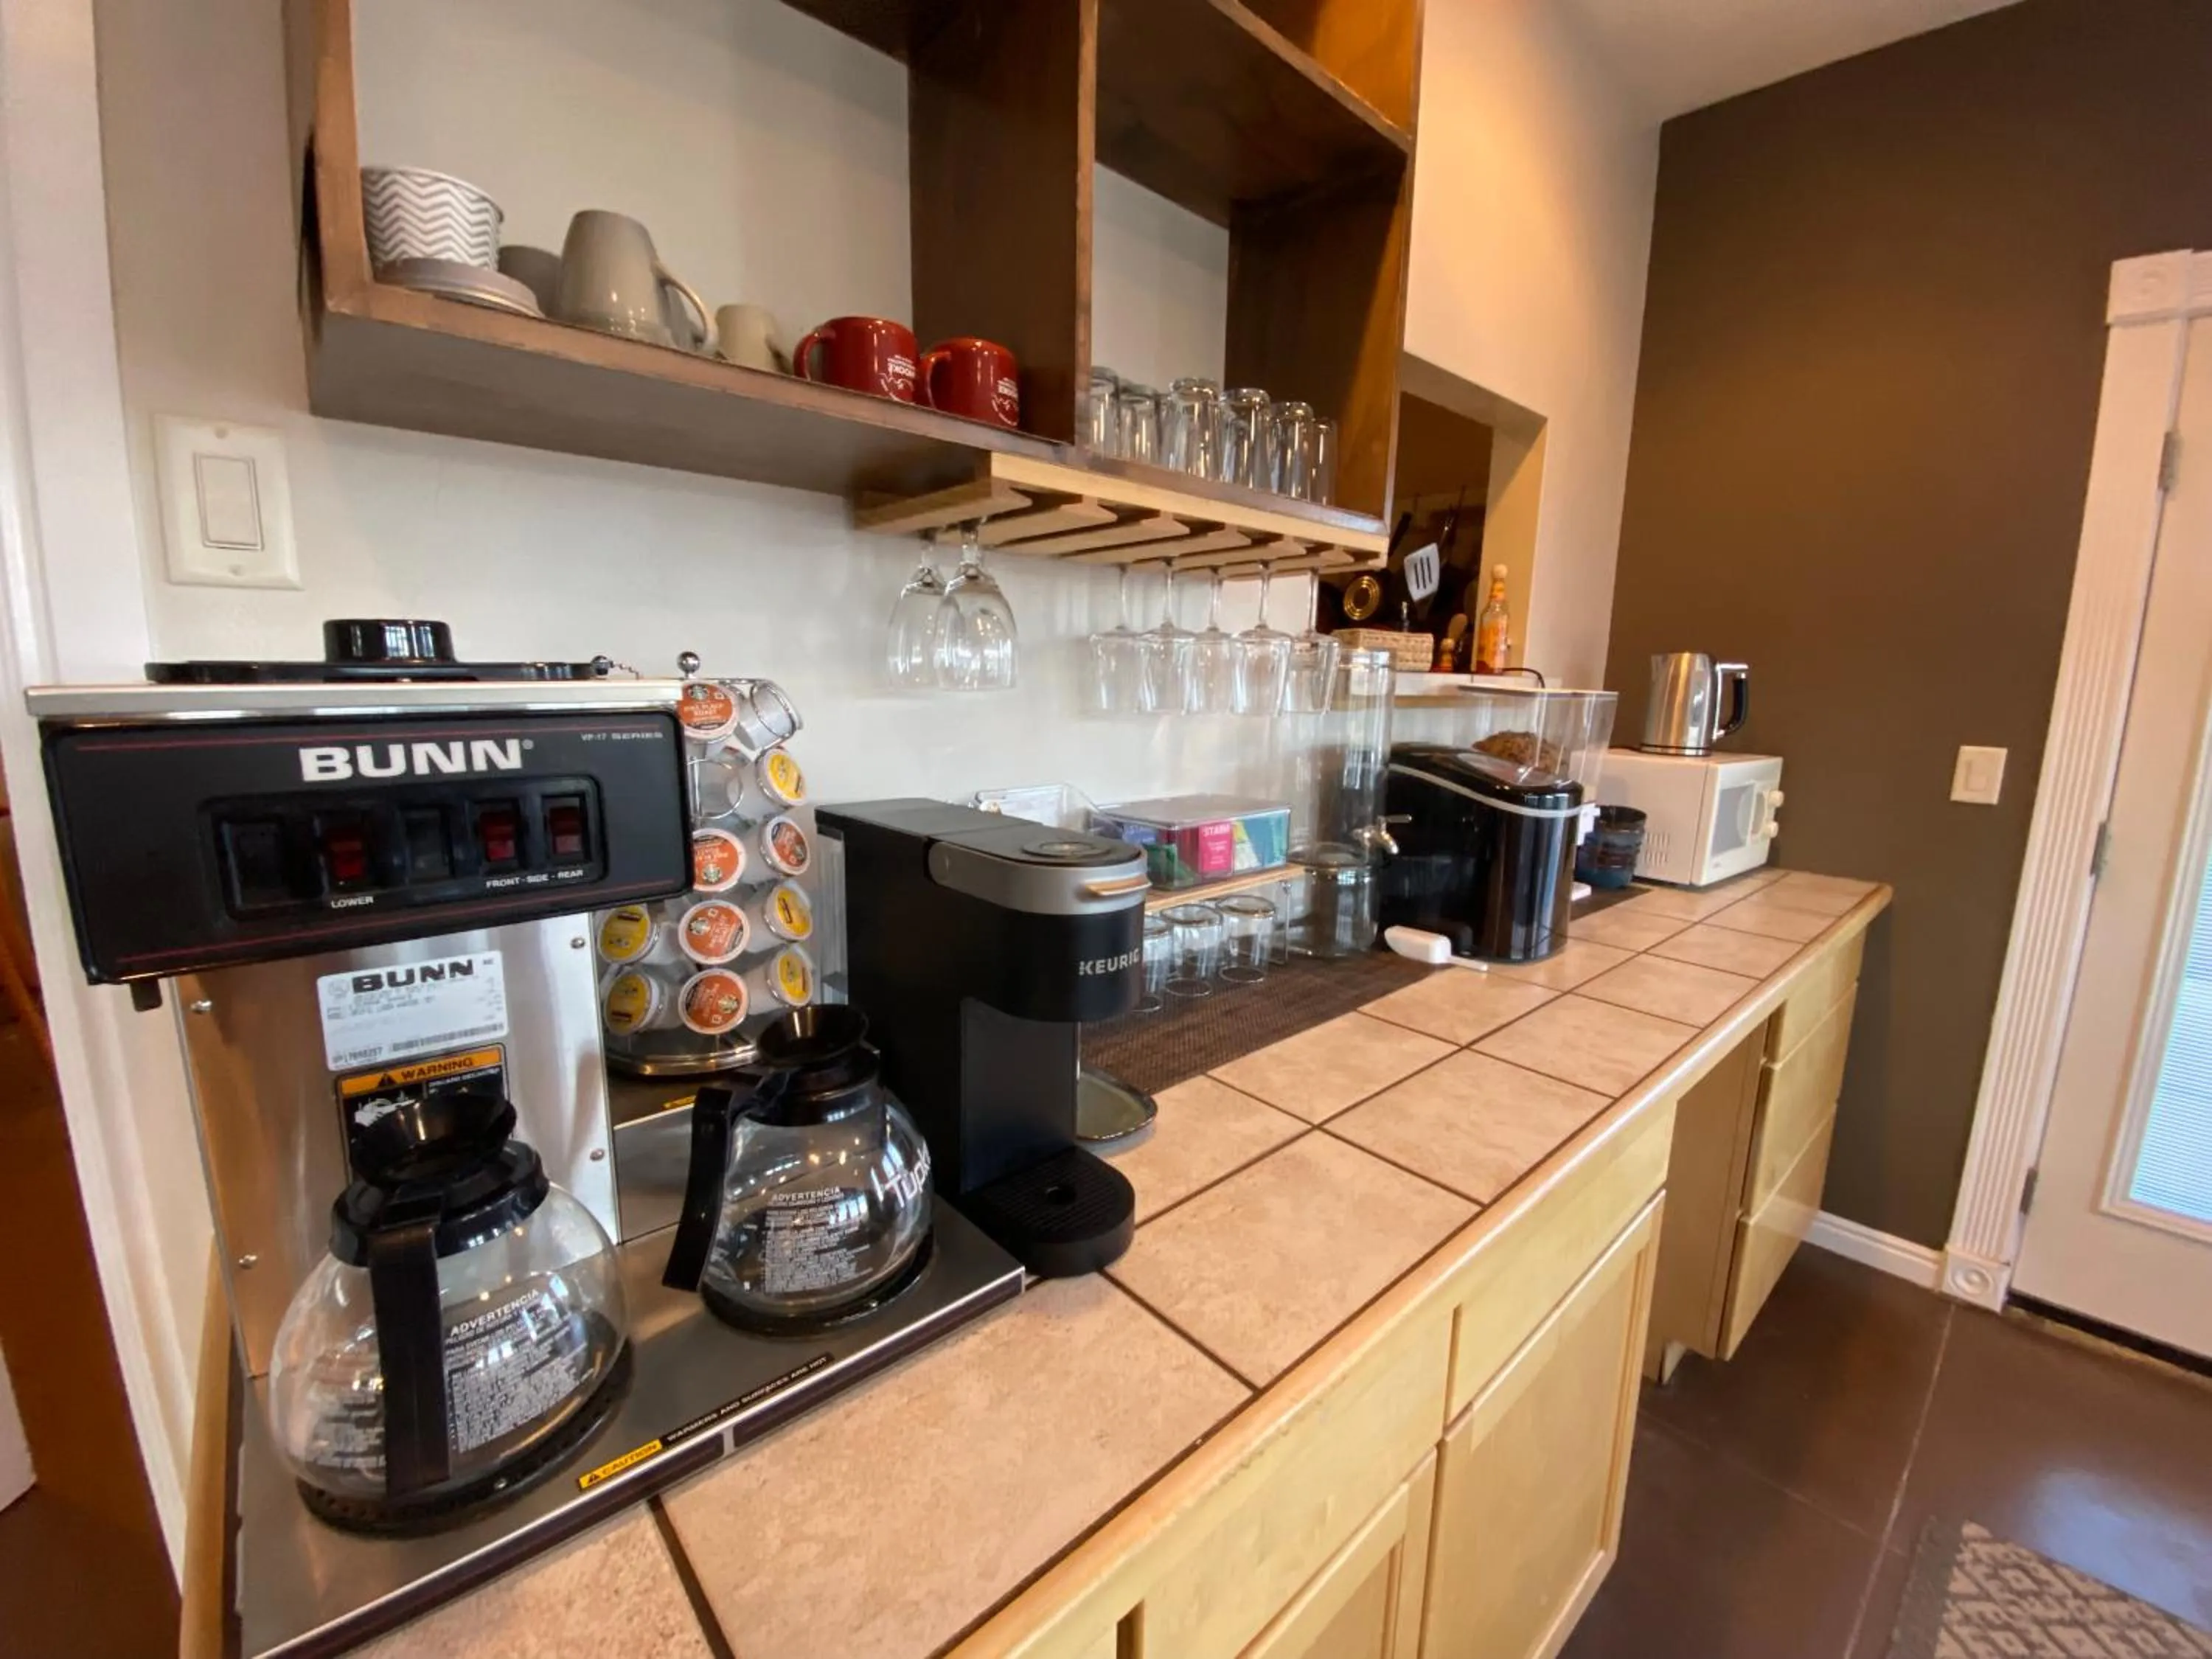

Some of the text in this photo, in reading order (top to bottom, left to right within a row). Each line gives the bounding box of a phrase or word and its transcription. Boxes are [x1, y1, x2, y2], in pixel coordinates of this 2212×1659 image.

[611, 731, 663, 740] SERIES
[299, 739, 523, 782] BUNN
[486, 877, 520, 888] FRONT
[526, 874, 549, 883] SIDE
[557, 869, 583, 879] REAR
[330, 896, 374, 908] LOWER
[352, 959, 474, 994] BUNN
[400, 1057, 474, 1080] WARNING
[771, 1186, 841, 1202] ADVERTENCIA
[451, 1288, 540, 1337] ADVERTENCIA
[602, 1443, 658, 1475] CAUTION
[720, 1401, 740, 1415] AND
[790, 1366, 809, 1378] ARE
